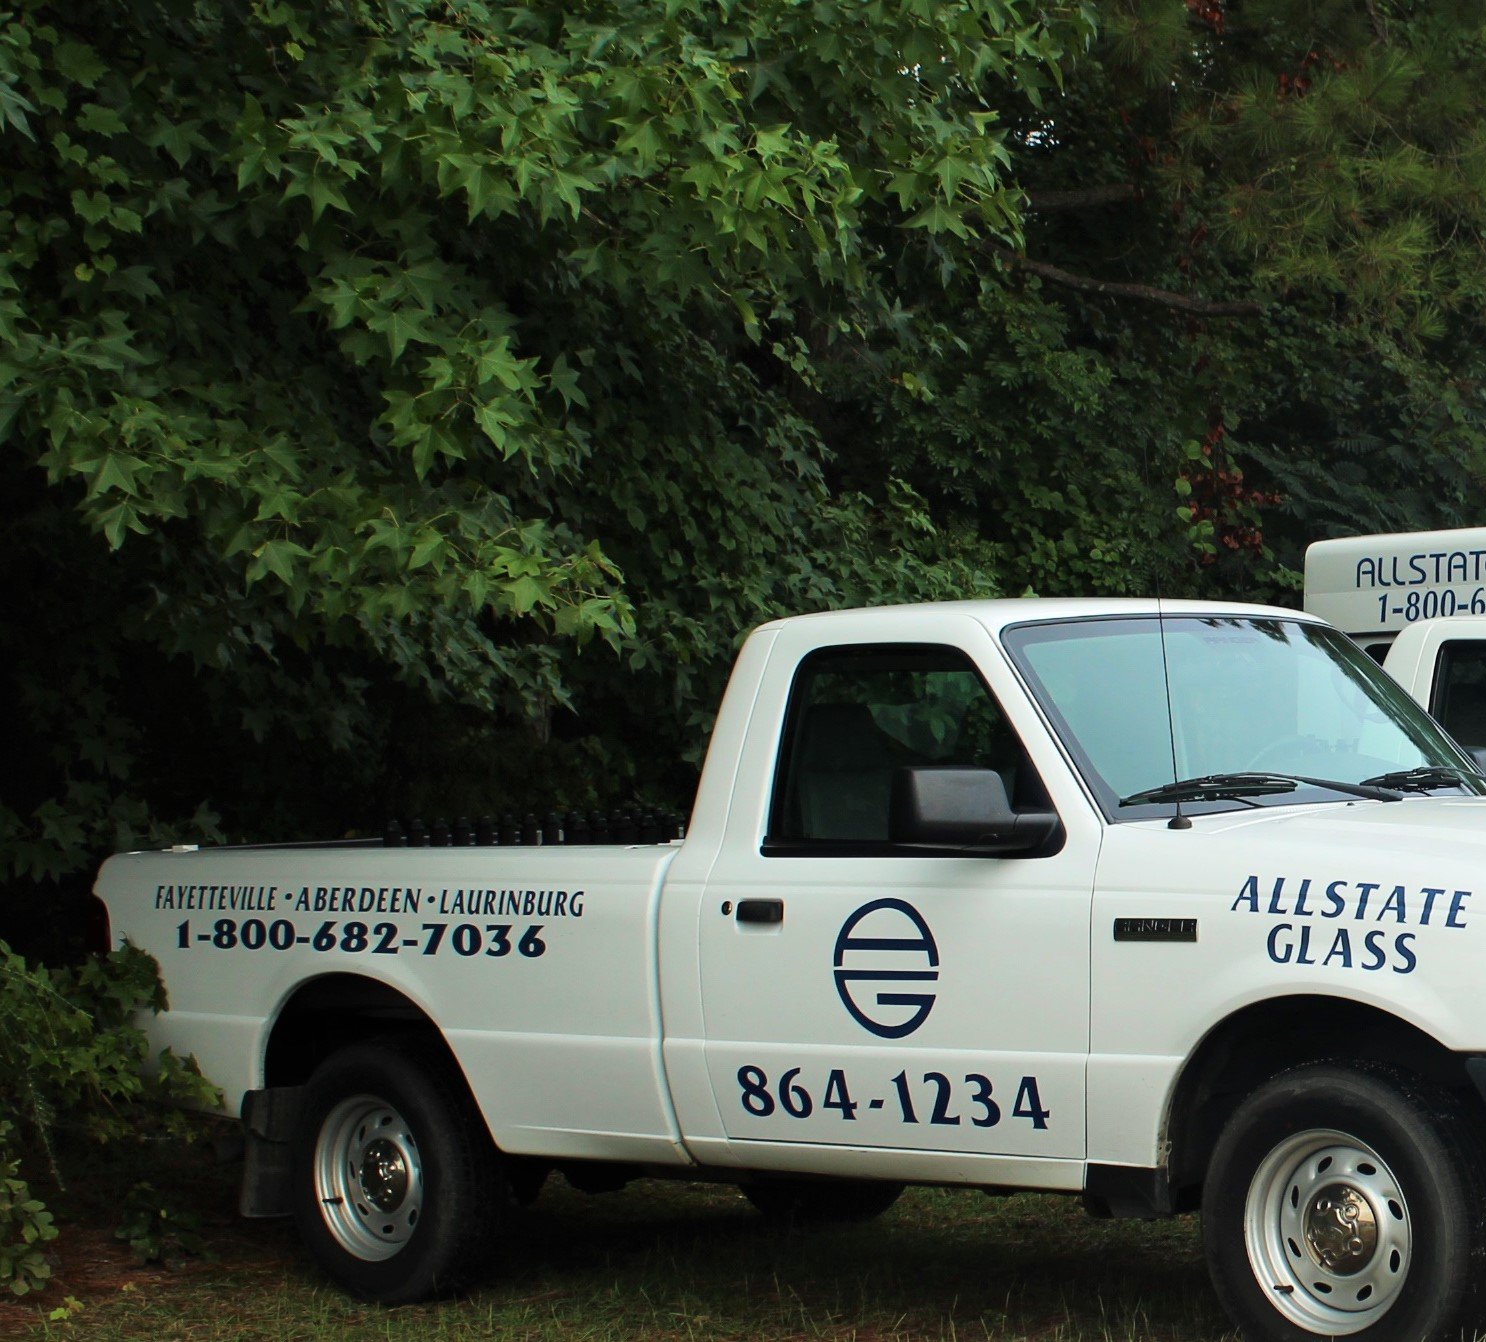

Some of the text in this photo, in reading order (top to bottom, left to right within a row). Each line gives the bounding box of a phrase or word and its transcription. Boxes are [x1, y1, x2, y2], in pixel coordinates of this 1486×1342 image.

[154, 885, 585, 918] FAYETTEVILLE ABERDEEN LAURINBURG
[1231, 875, 1472, 929] ALLSTATE
[176, 918, 547, 958] 1-800-682-7036
[1267, 923, 1417, 974] GLASS
[736, 1064, 1050, 1130] 864-1234
